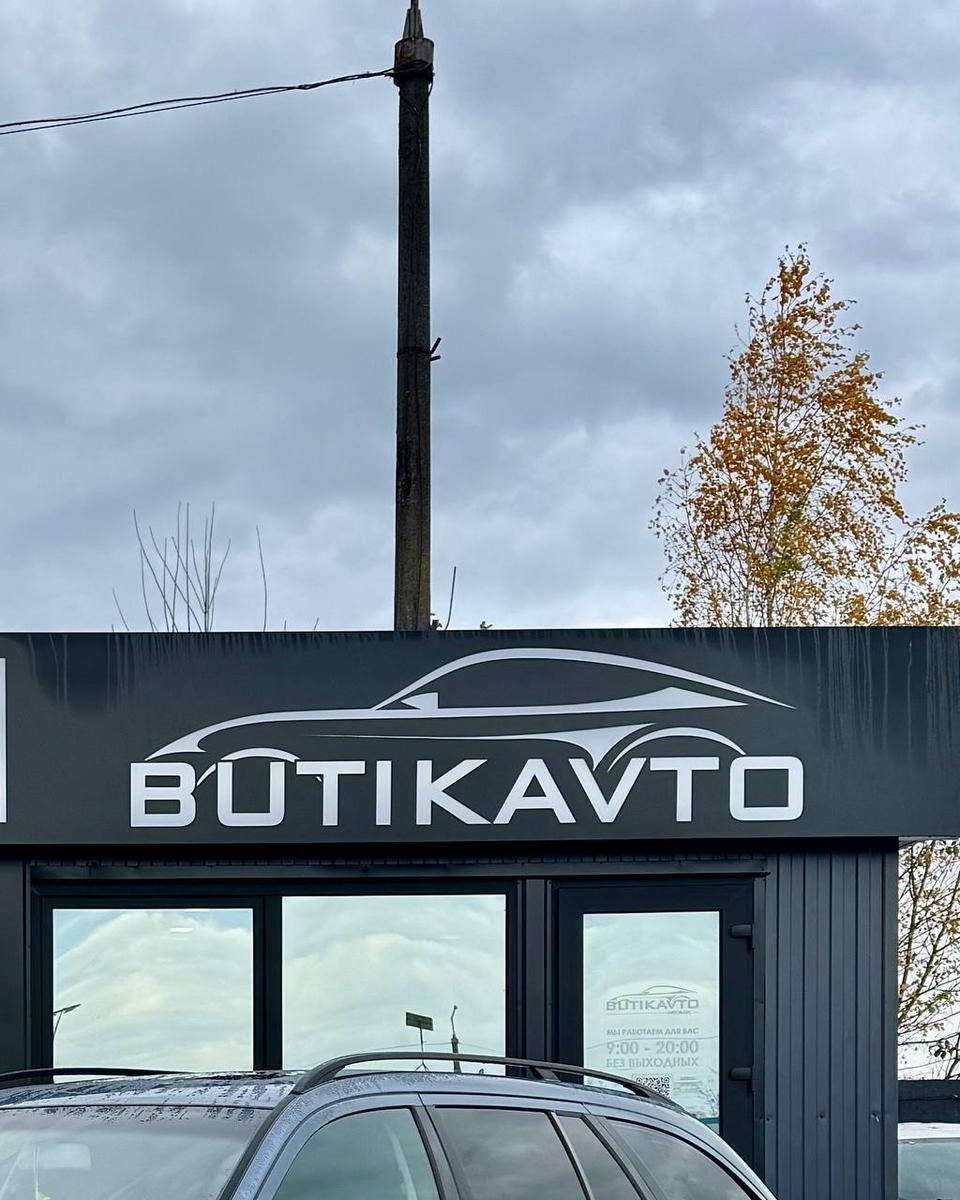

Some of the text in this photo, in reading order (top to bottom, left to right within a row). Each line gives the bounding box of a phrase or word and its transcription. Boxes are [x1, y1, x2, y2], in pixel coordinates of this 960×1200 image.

[130, 755, 806, 828] BUTIKAVTO
[606, 999, 699, 1011] BUTIKAVTO
[606, 1041, 639, 1054] 9:00
[656, 1040, 699, 1054] 20:00
[606, 1057, 699, 1068] БЕЗ ВЫХОДНЫХ
